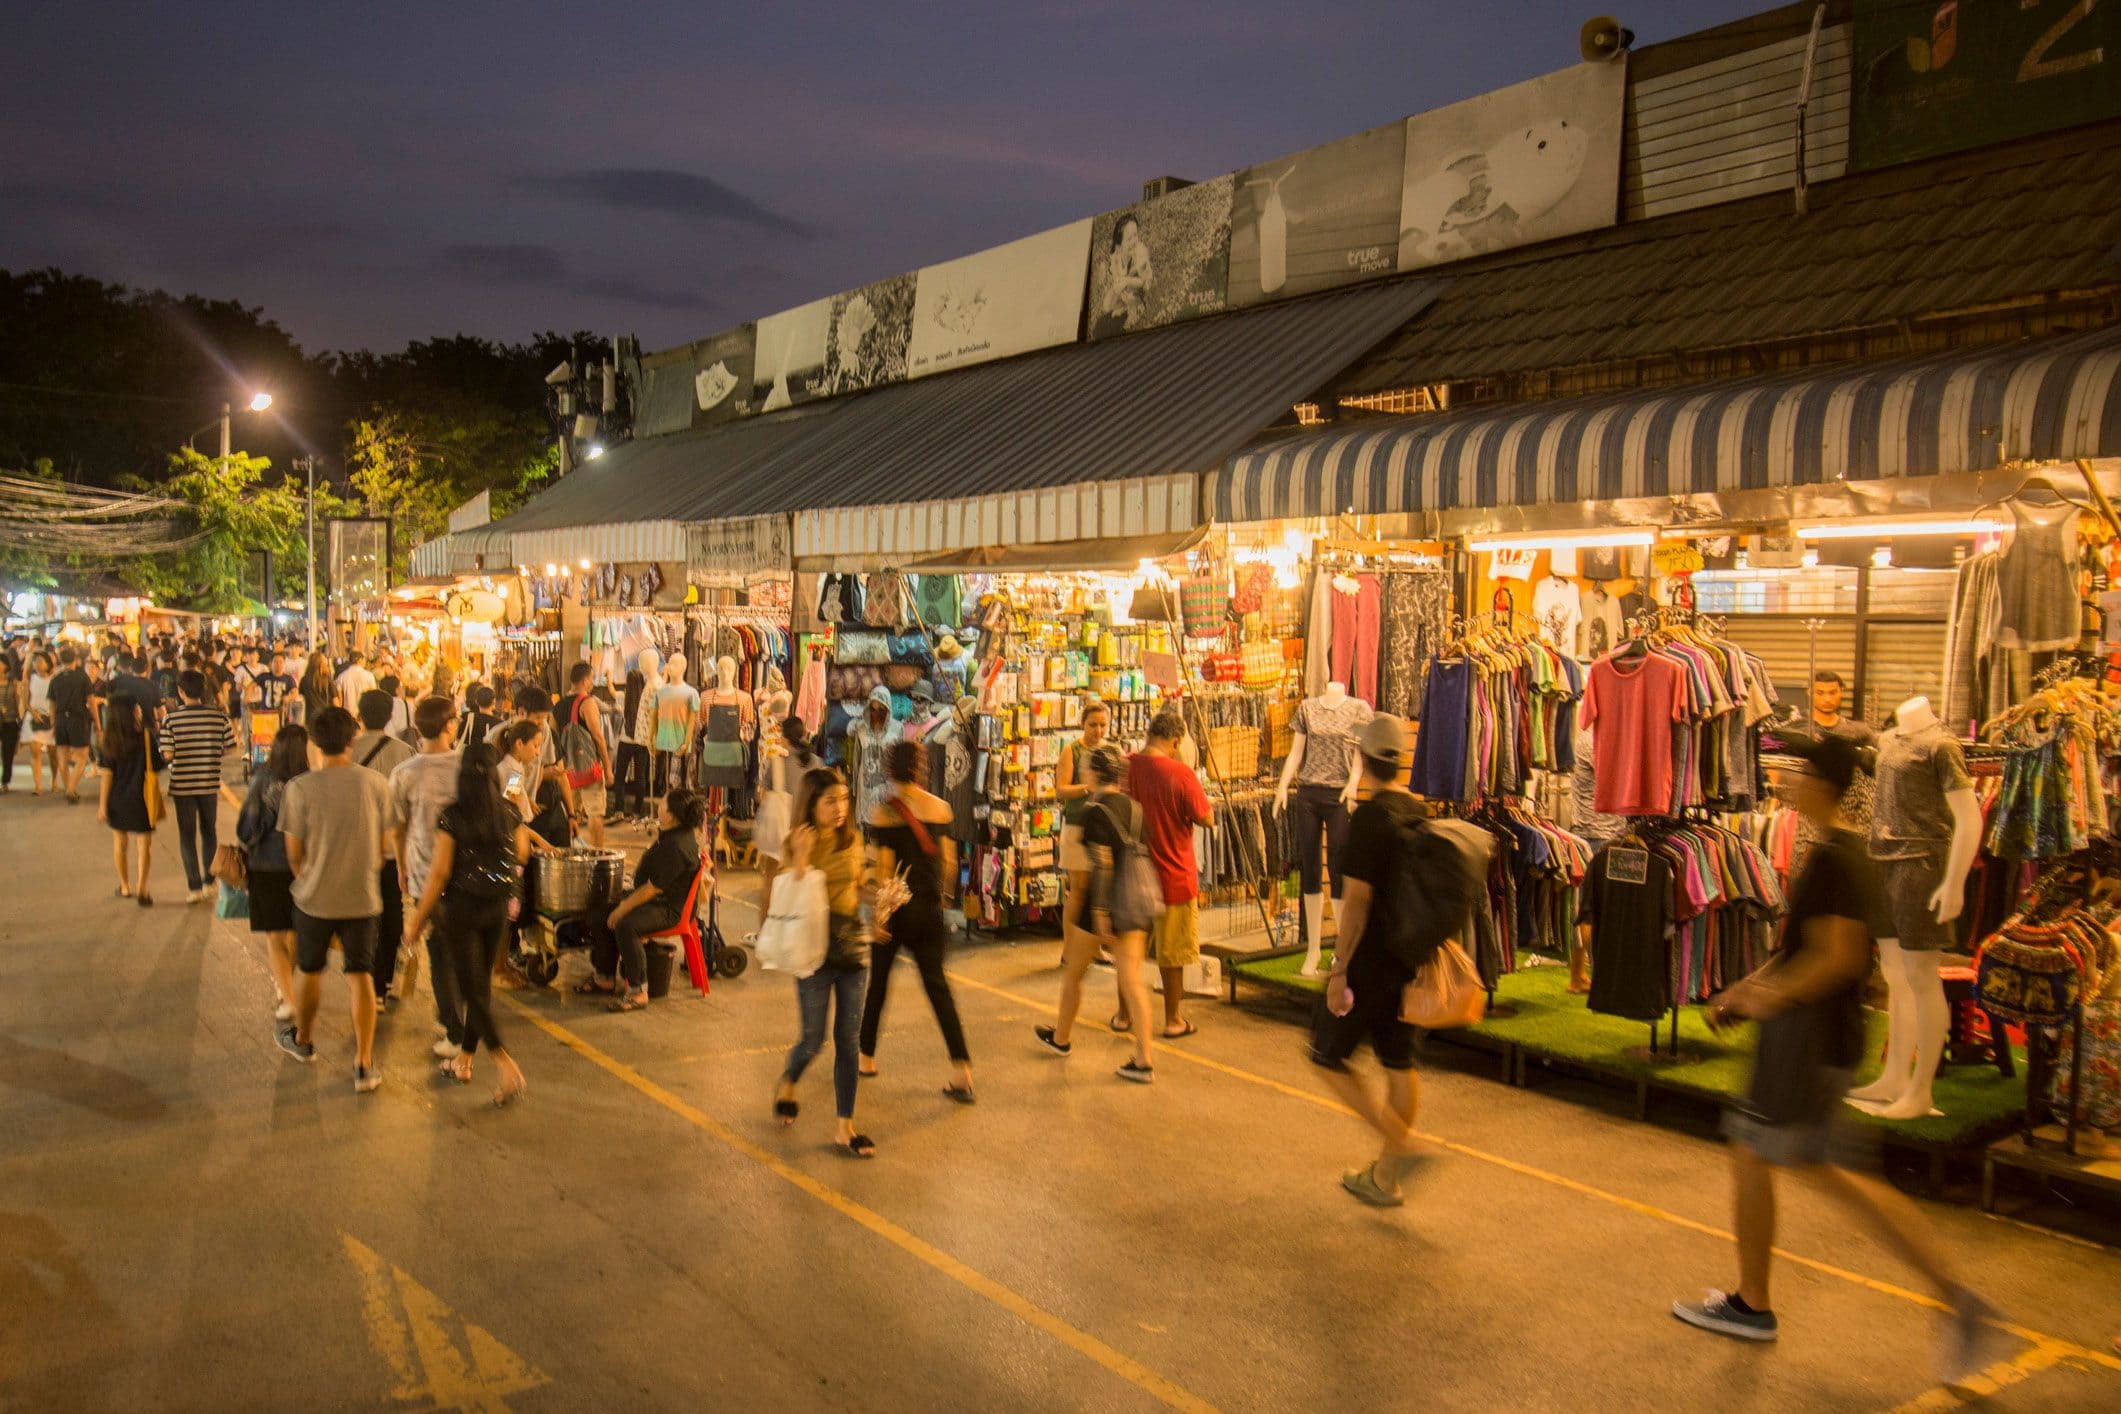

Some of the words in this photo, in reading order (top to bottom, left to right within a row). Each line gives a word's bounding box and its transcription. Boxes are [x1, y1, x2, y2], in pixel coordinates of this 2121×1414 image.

[1347, 246, 1380, 266] true
[1360, 257, 1391, 273] move
[1188, 288, 1216, 306] true
